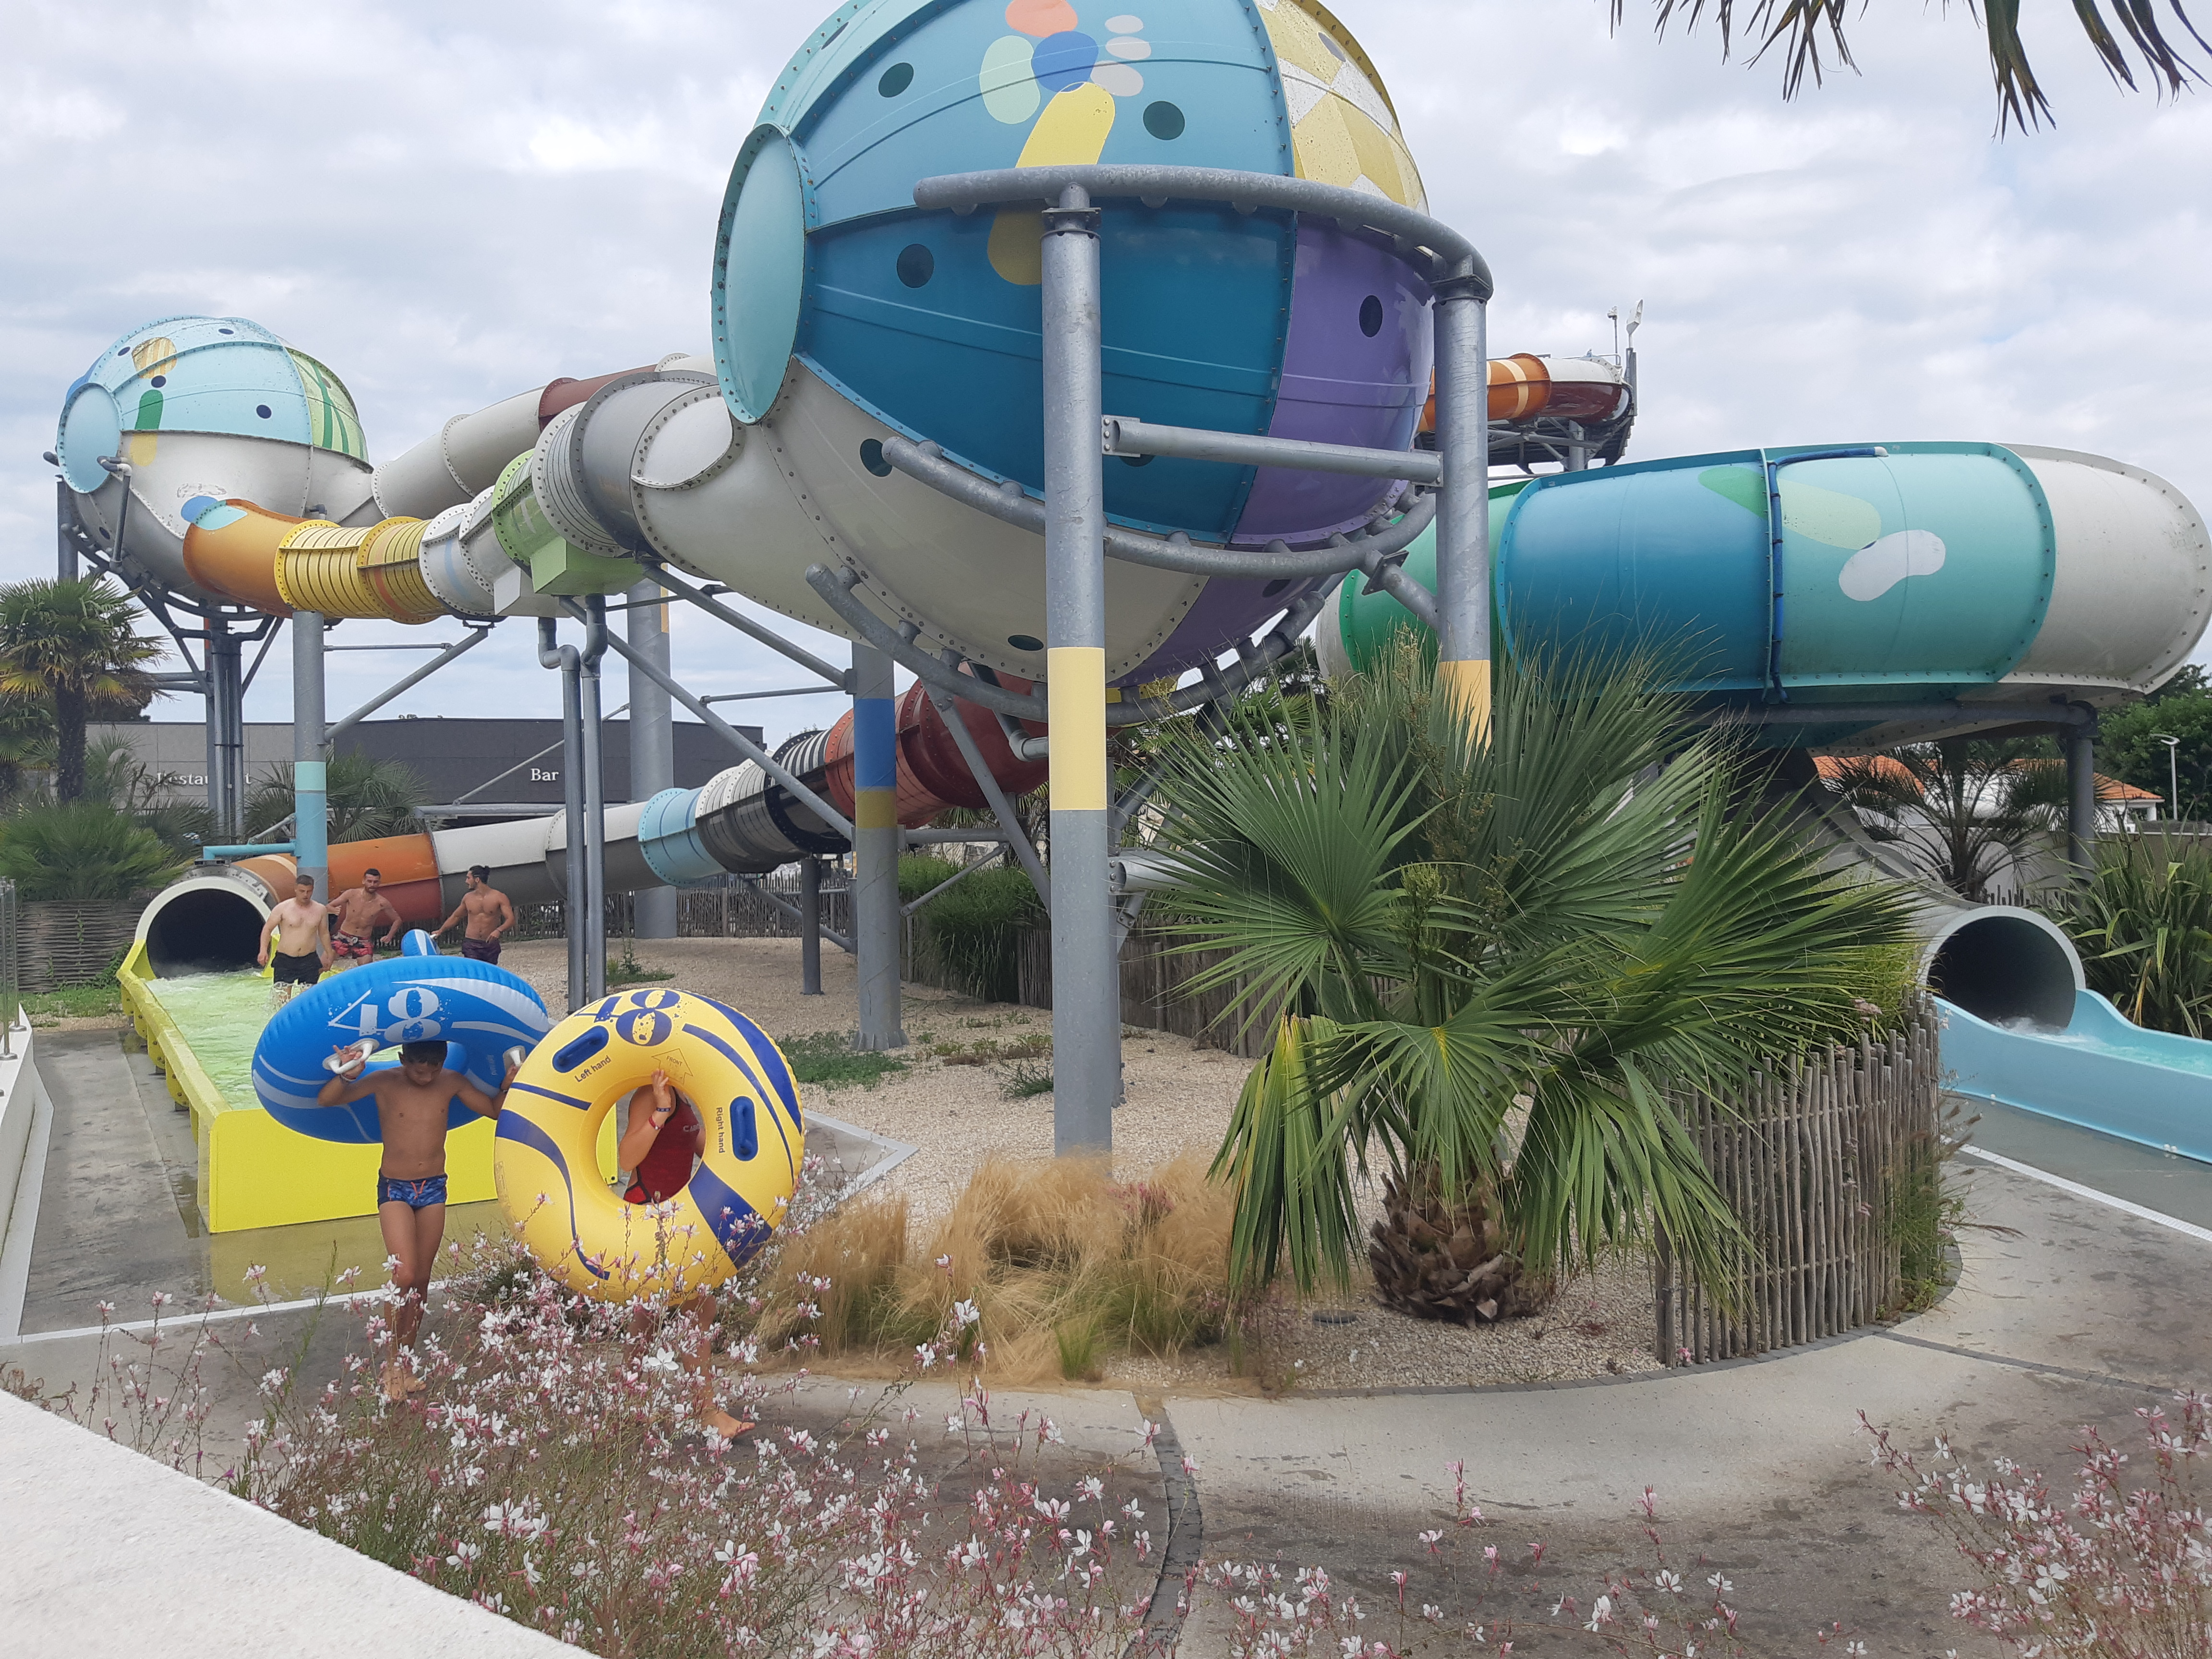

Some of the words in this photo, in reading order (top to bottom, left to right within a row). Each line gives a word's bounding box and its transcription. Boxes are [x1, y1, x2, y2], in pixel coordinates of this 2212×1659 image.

[530, 768, 559, 781] Bar
[328, 986, 442, 1043] 48
[574, 989, 680, 1046] 48
[574, 1069, 592, 1082] Left
[590, 1055, 612, 1072] hand
[666, 1055, 683, 1067] FRONT
[715, 1107, 724, 1130] Right
